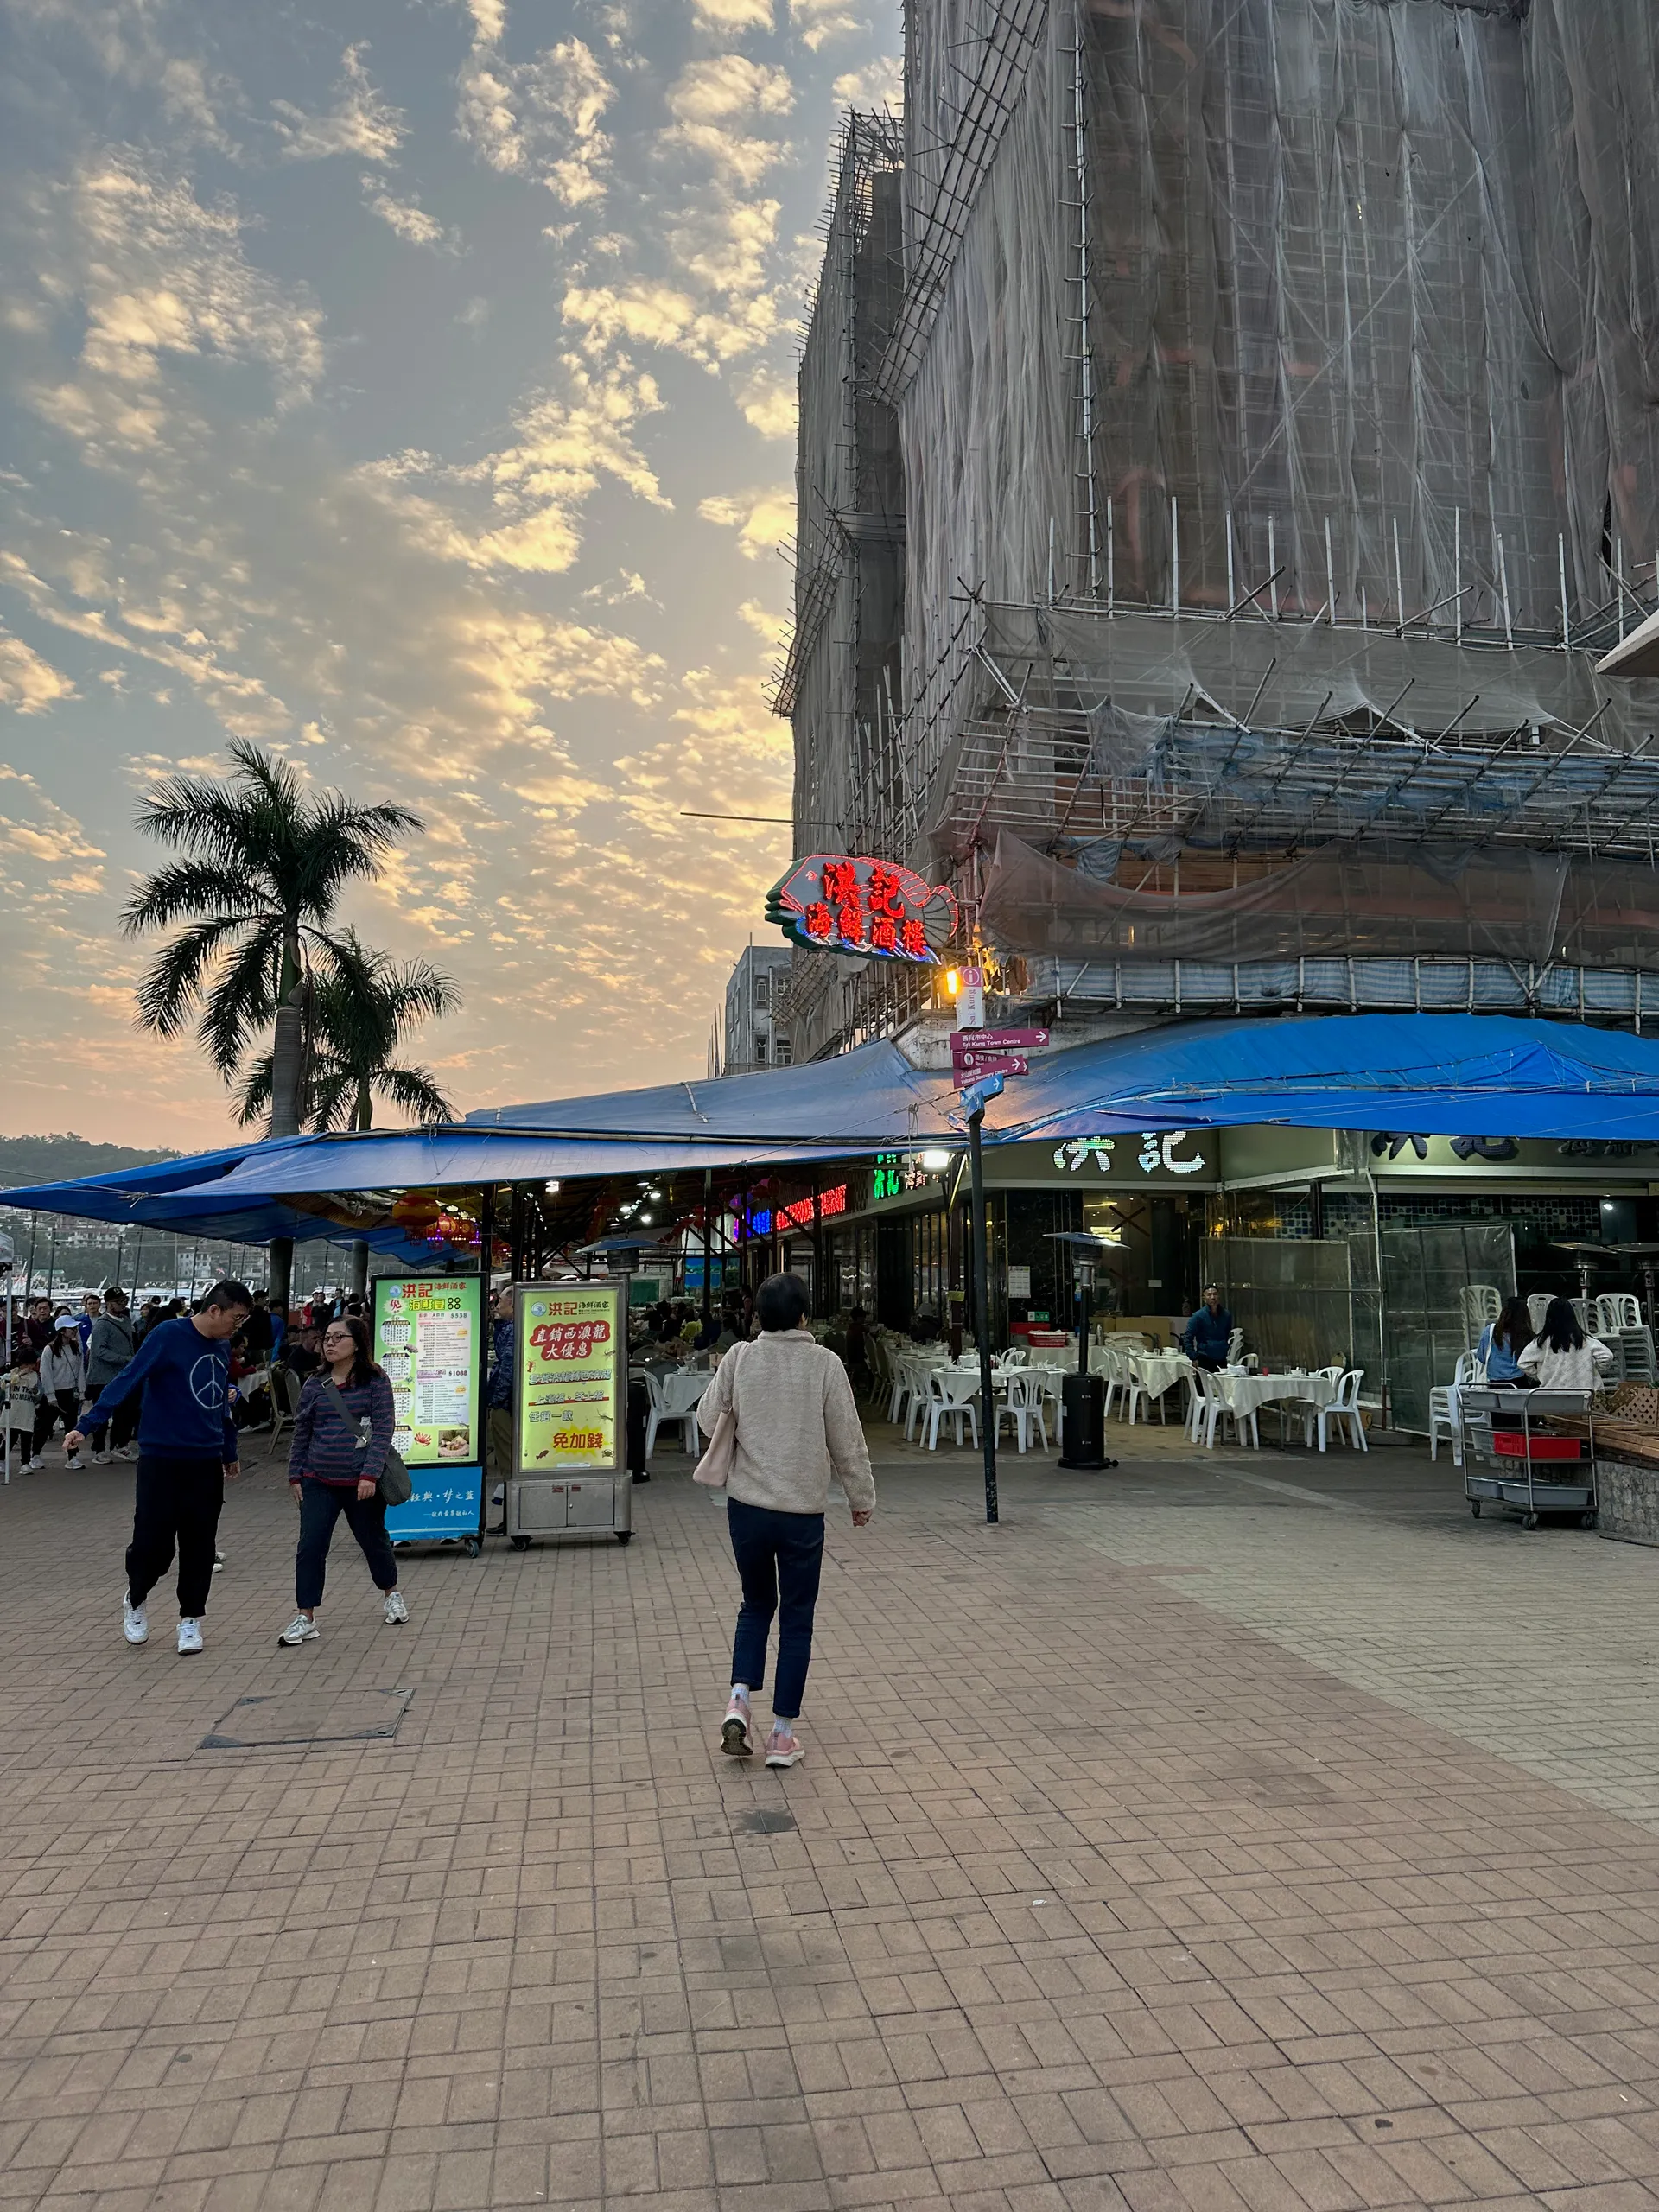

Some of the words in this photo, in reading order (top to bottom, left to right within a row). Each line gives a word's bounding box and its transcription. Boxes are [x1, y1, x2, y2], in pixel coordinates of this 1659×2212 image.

[823, 861, 906, 919] 洪記
[968, 988, 976, 1010] Kung
[968, 1013, 976, 1026] Sai
[975, 1071, 994, 1081] Discovery
[402, 1283, 433, 1298] 洪記
[549, 1302, 578, 1316] 洪記
[578, 1300, 609, 1309] 海鮮酒家
[534, 1324, 606, 1344] 直銷西澳龍
[545, 1341, 588, 1359] 大優惠
[529, 1410, 574, 1422] 任選一款
[553, 1432, 603, 1449] 免加錢
